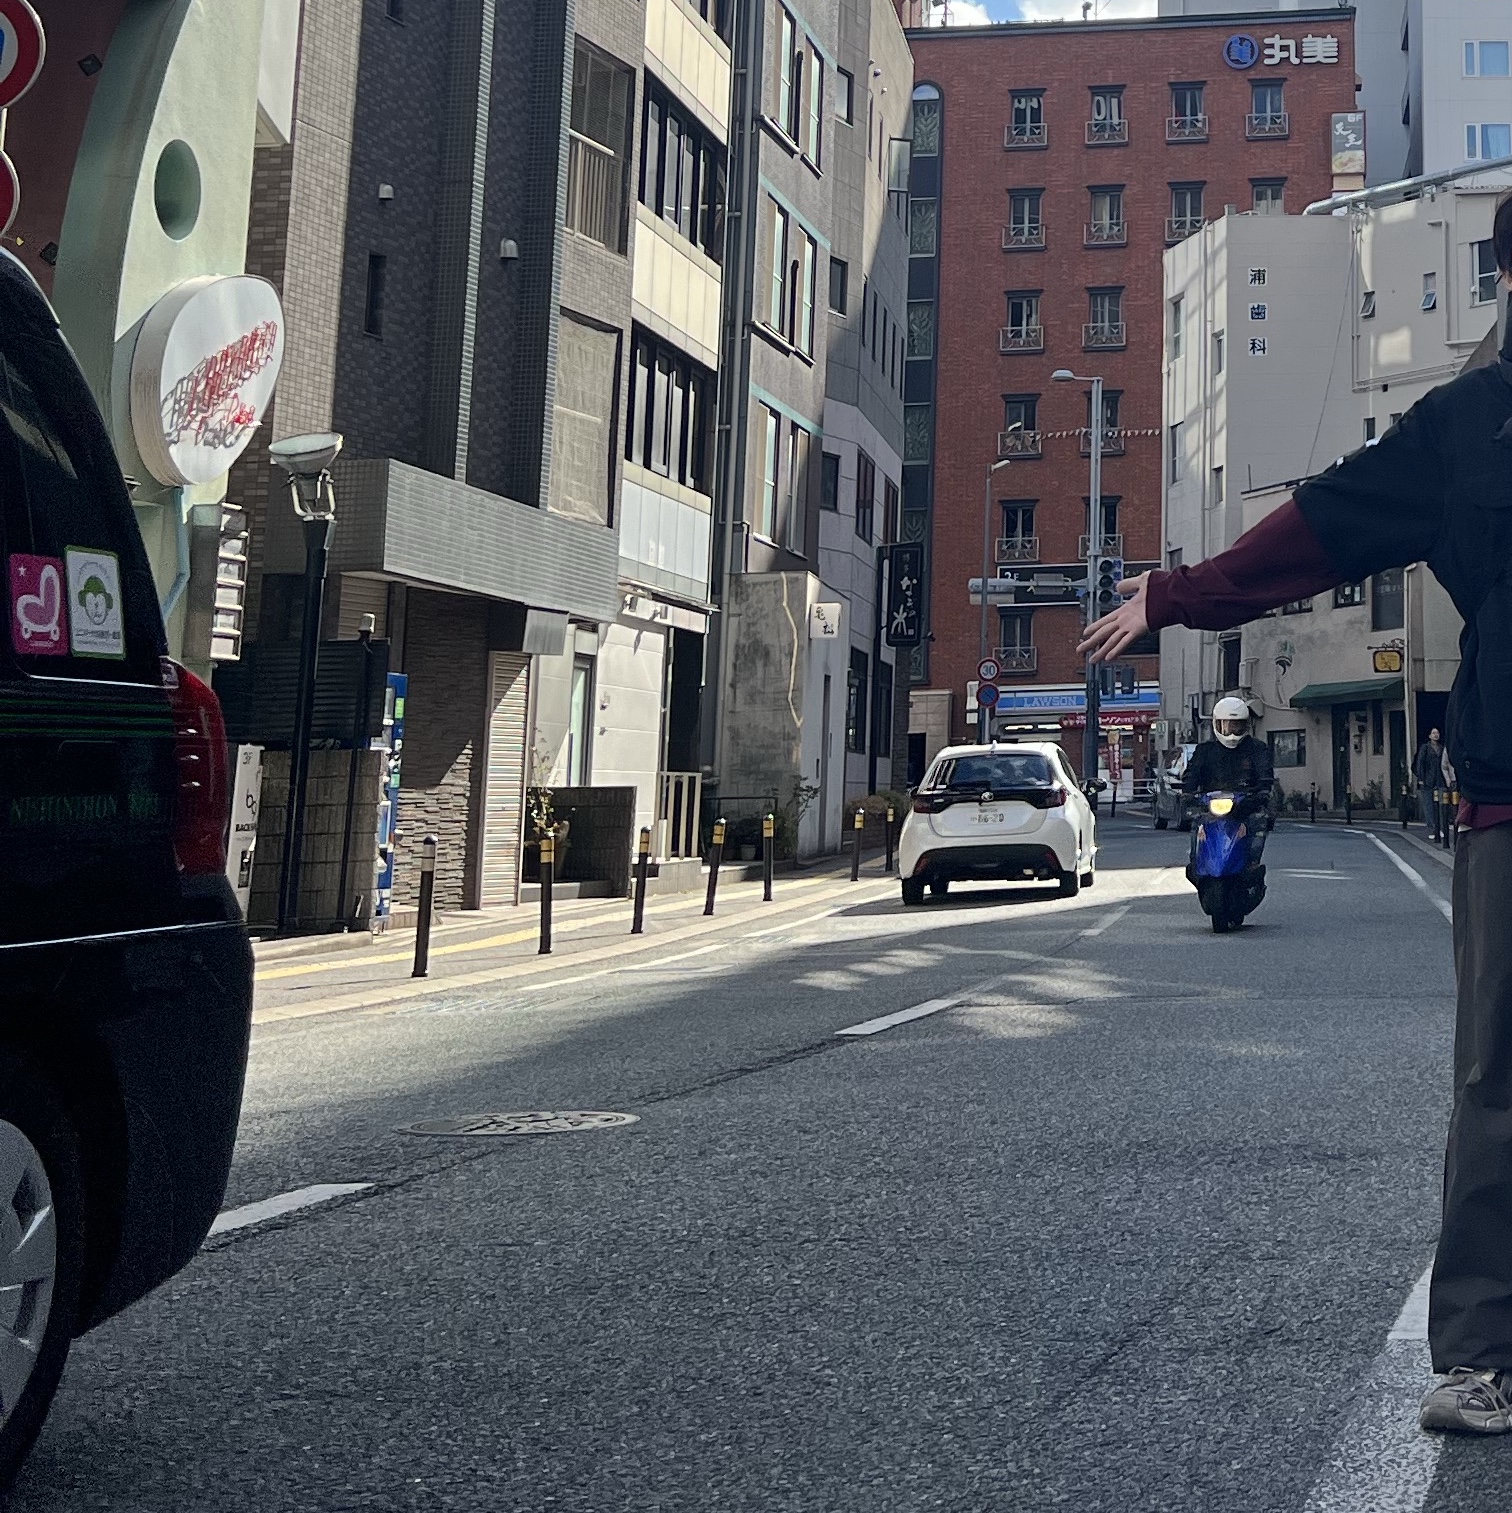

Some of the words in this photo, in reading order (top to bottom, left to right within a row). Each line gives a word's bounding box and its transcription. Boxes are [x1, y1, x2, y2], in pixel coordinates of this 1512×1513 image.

[1263, 33, 1339, 66] 丸美
[1248, 267, 1267, 355] 浦歯科
[982, 664, 996, 677] 30
[1023, 694, 1077, 708] LAWSON
